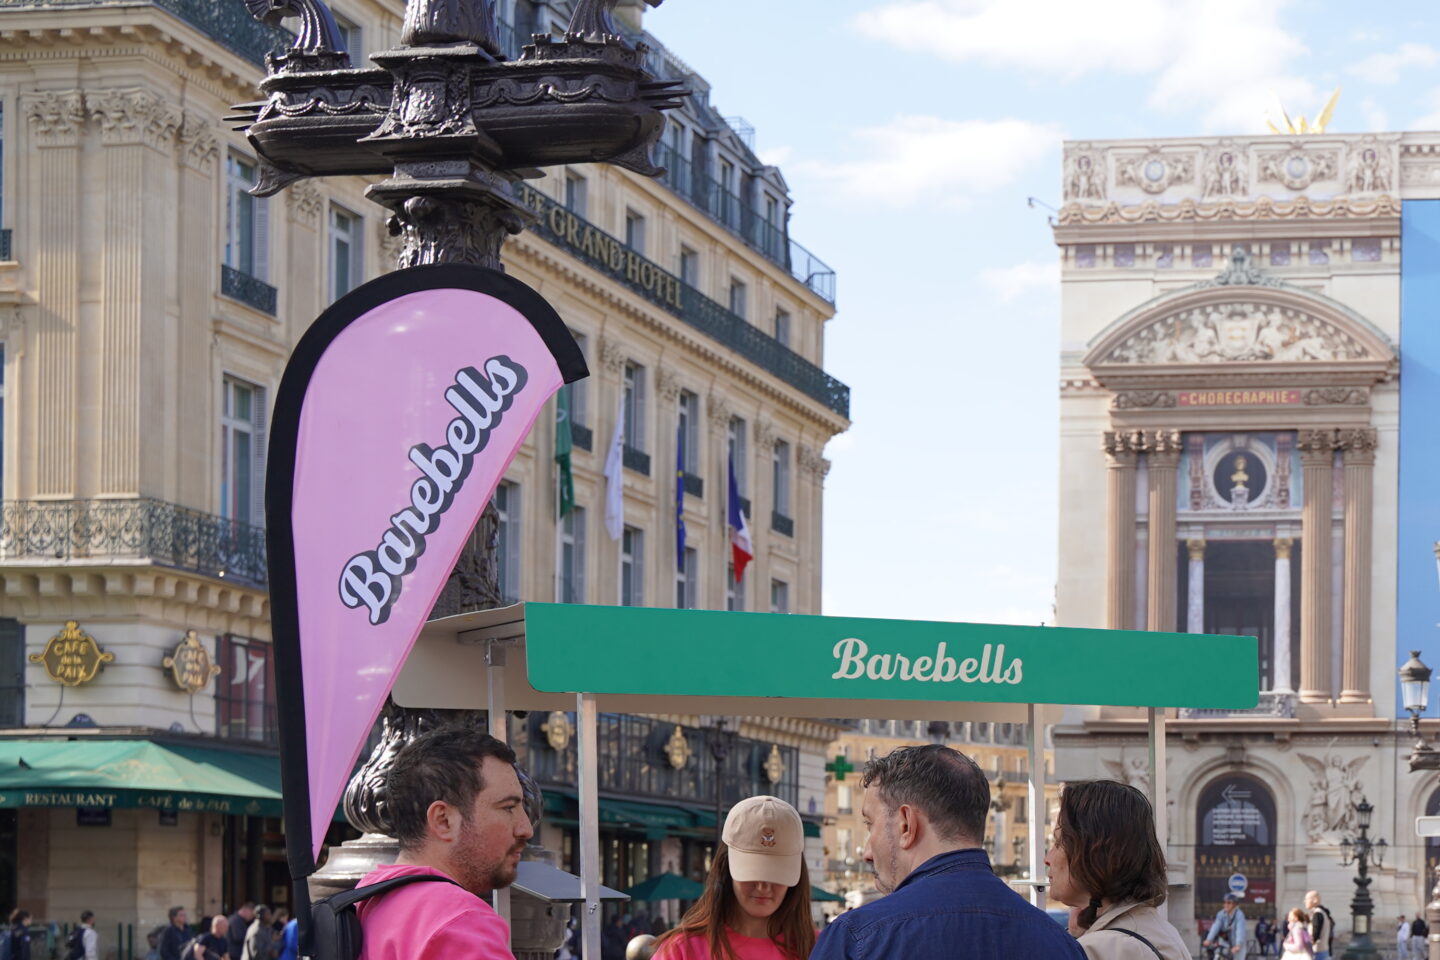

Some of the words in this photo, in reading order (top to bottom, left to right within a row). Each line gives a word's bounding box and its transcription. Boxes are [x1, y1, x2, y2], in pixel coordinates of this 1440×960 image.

[551, 206, 624, 271] GRAND
[626, 251, 683, 309] HOTEL
[1189, 390, 1289, 405] CHOREGRAPHIE
[339, 355, 527, 625] Barebells
[56, 665, 87, 679] PAIX
[831, 637, 1024, 685] Barebells
[25, 792, 117, 807] RESTAURANT
[178, 797, 193, 809] de
